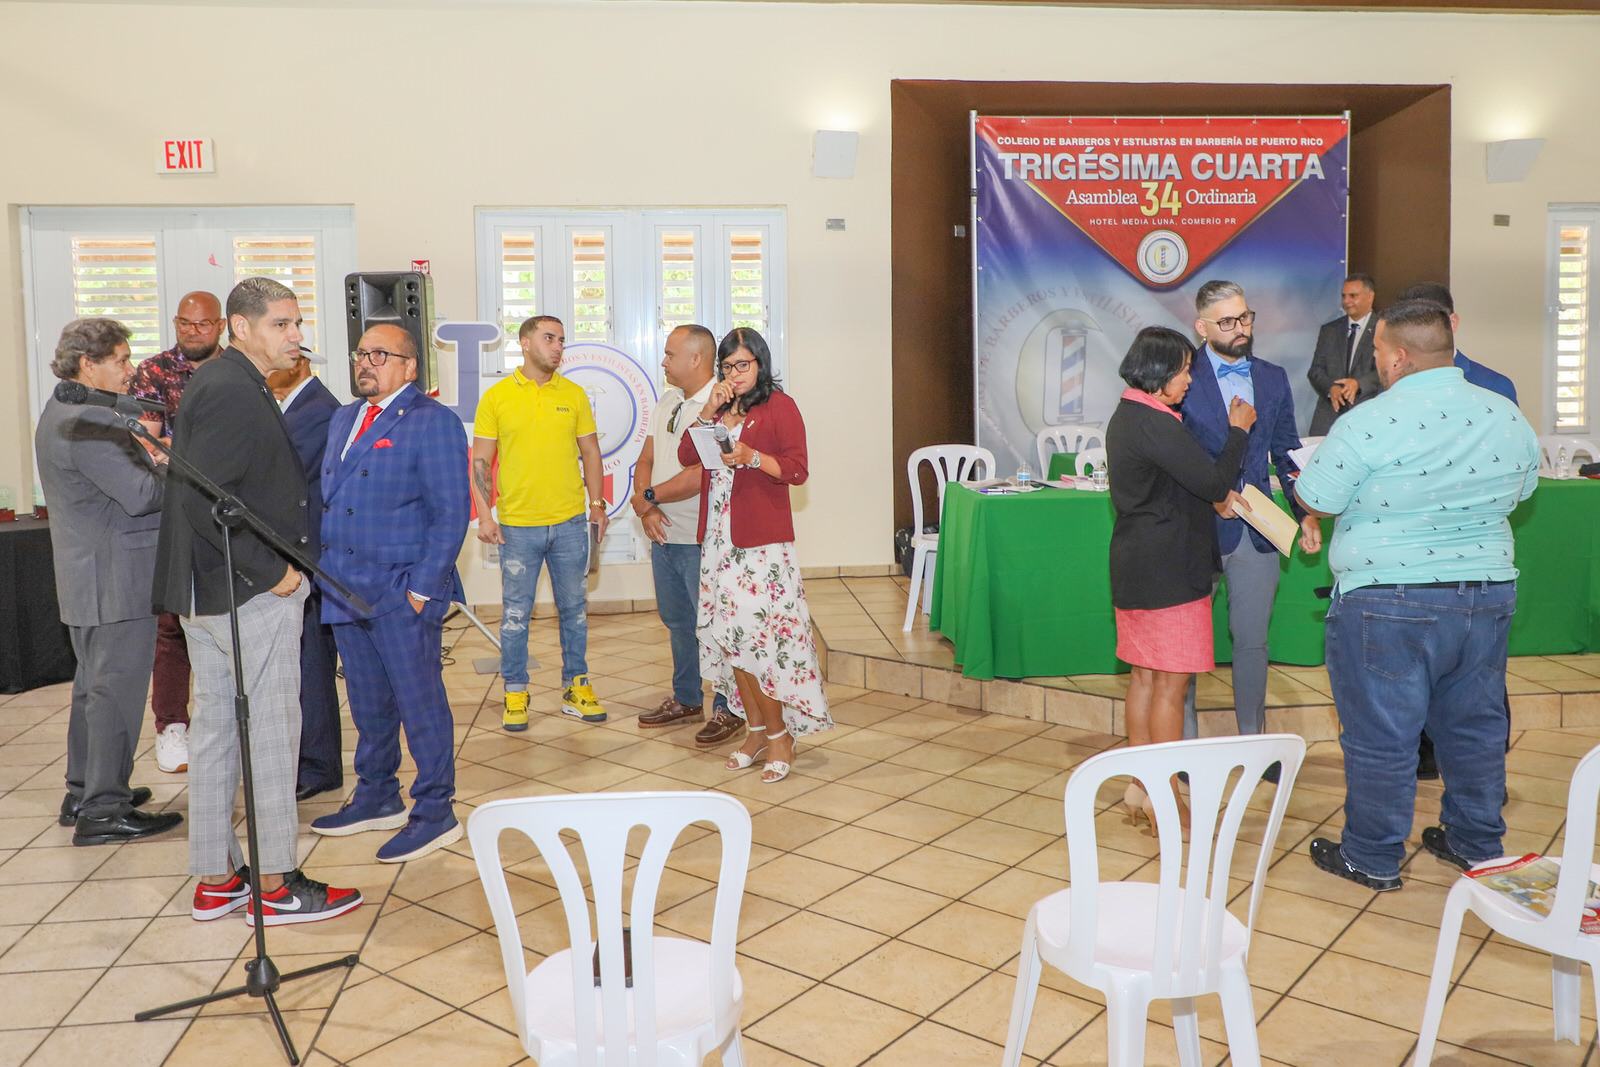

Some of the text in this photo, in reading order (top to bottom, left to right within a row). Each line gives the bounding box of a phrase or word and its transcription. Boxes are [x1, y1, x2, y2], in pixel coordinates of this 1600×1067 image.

[164, 140, 203, 169] EXIT
[997, 136, 1324, 146] COLEGIO DE BARBEROS Y ESTILISTAS EN BARBERÍA DE PUERTO RICO
[998, 147, 1325, 181] TRIGÉSIMA CUARTA
[1065, 181, 1257, 217] Asamblea 34 Ordinaria
[1089, 218, 1118, 226] HOTEL
[1152, 218, 1178, 226] LUNA,
[1181, 217, 1222, 225] COMERÍO
[985, 287, 1057, 348] BARBEROS
[1074, 287, 1144, 334] ESTILISTA
[591, 353, 637, 384] ESTILISTAS
[635, 383, 645, 396] EN
[603, 458, 621, 472] ICO
